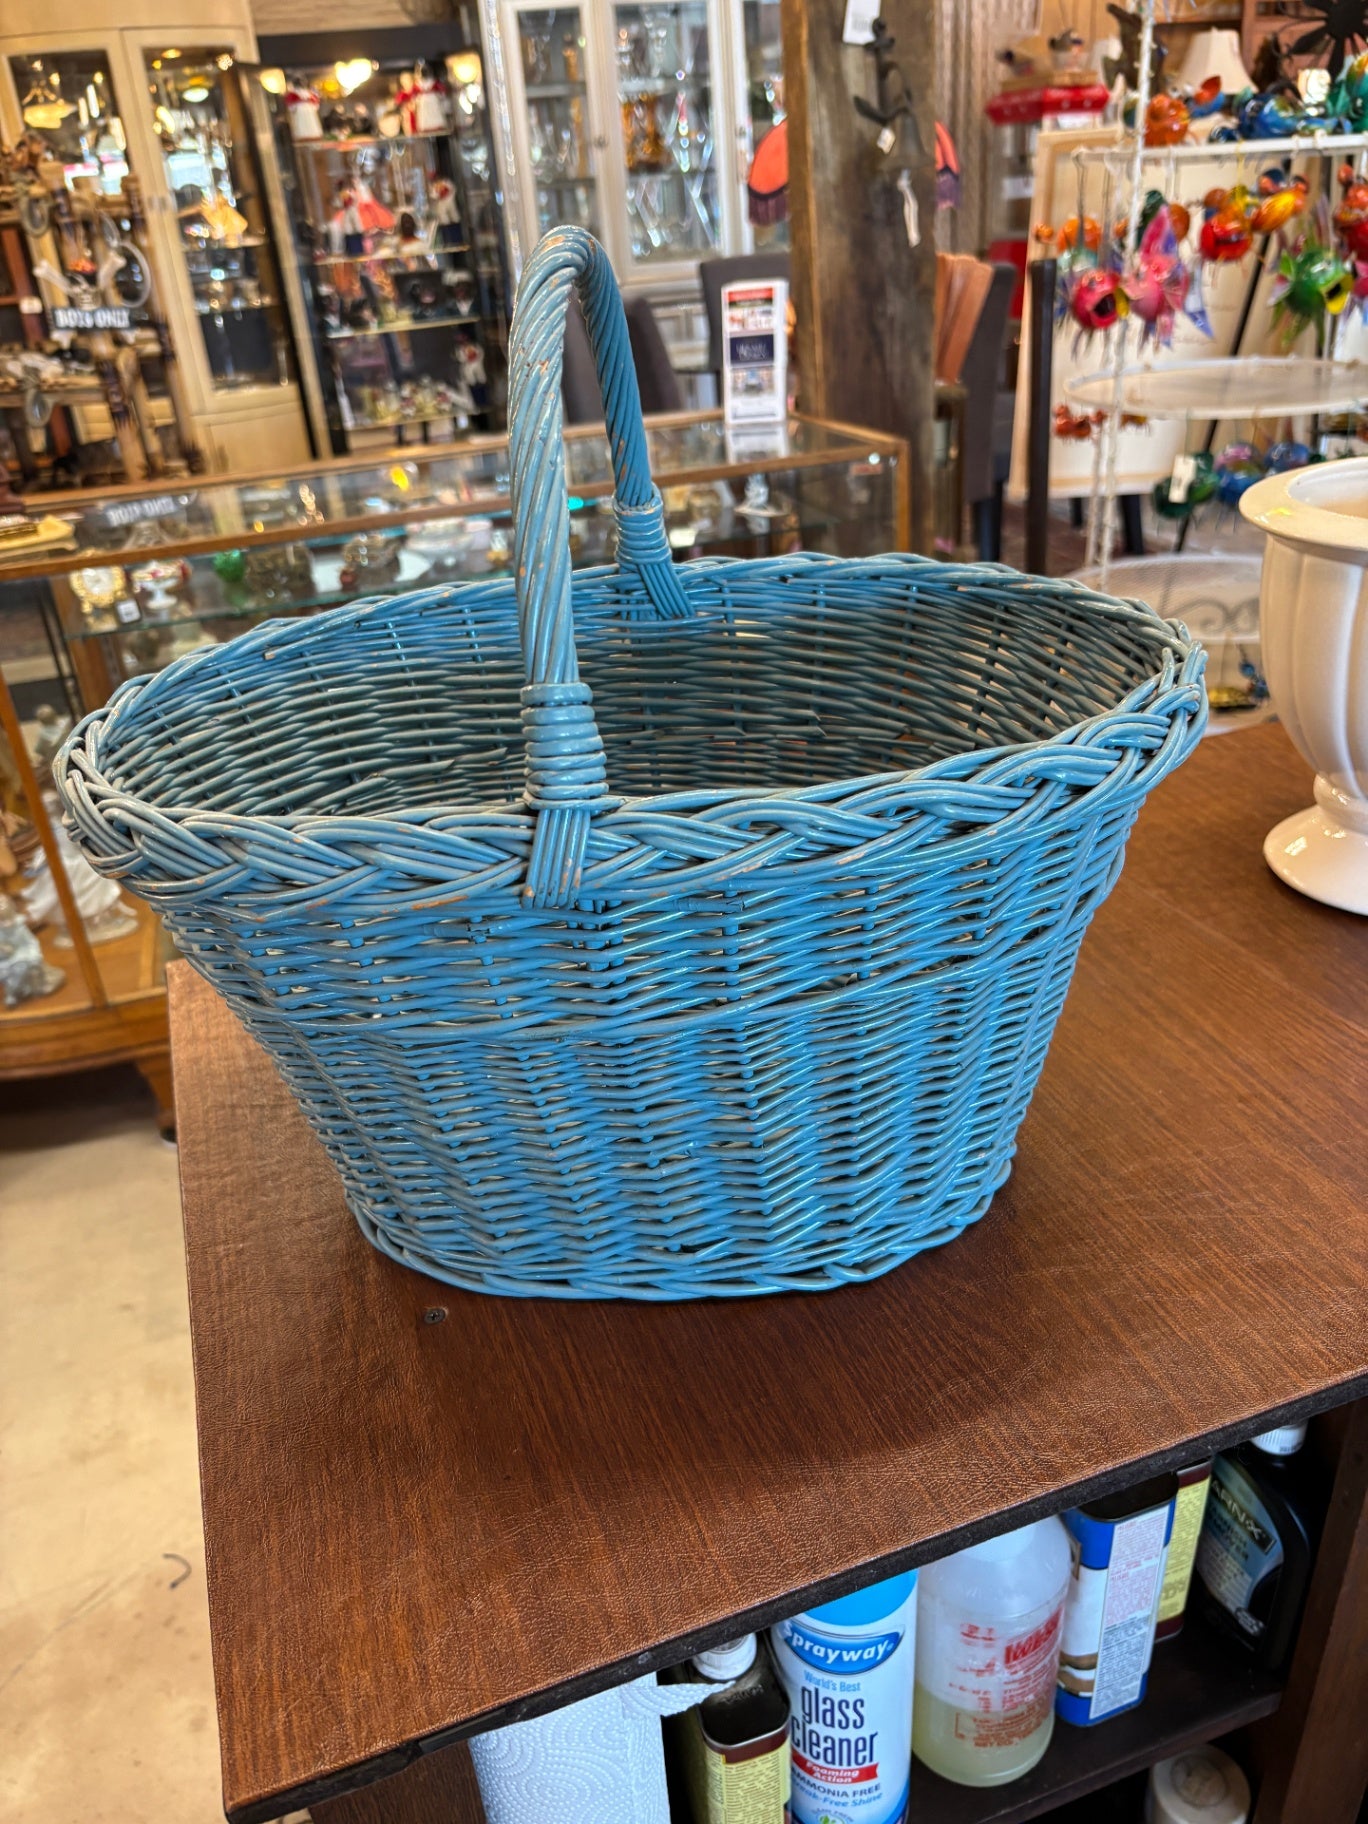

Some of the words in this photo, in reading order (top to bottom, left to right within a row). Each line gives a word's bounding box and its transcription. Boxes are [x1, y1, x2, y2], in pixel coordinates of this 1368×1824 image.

[779, 1619, 889, 1665] Sprayway
[804, 1669, 838, 1691] World's
[840, 1681, 861, 1693] Best
[801, 1685, 865, 1730] glass
[791, 1714, 878, 1767] cleaner
[806, 1761, 860, 1778] Foaming
[812, 1772, 853, 1784] Action
[852, 1782, 881, 1798] FREE
